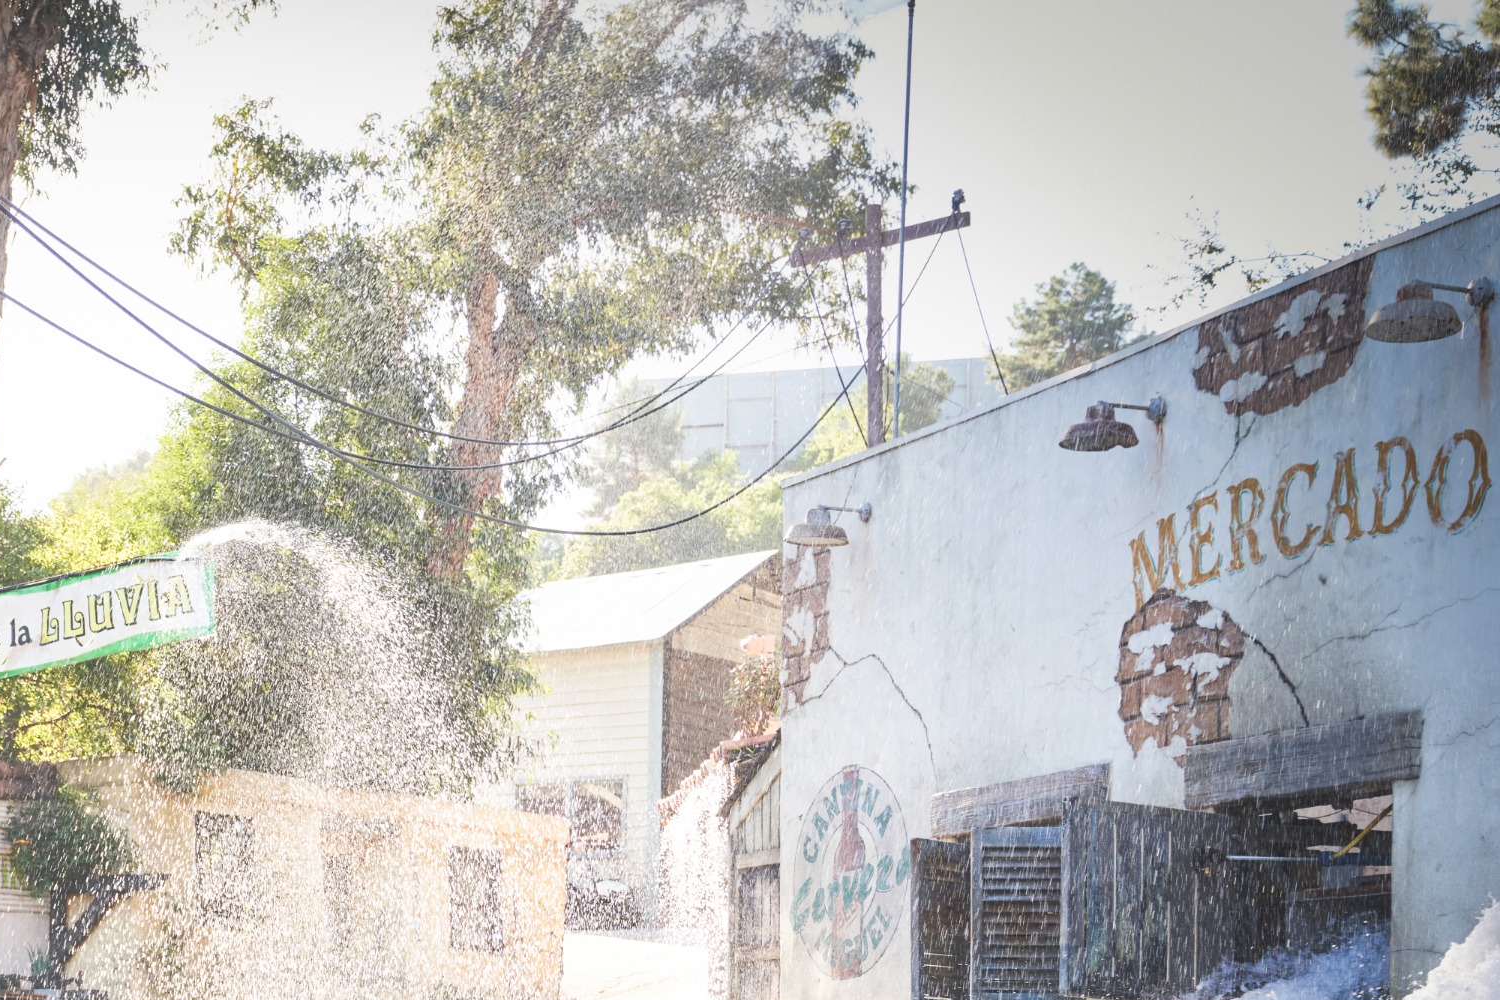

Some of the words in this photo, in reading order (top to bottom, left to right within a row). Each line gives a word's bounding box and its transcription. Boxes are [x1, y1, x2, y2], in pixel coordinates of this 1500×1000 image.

[1129, 429, 1492, 613] MERCADO
[9, 618, 32, 647] la
[39, 574, 194, 648] LLUVIA
[803, 779, 893, 864] CANTINA
[790, 845, 912, 934] Cerveza
[814, 905, 891, 970] MIGUEL
